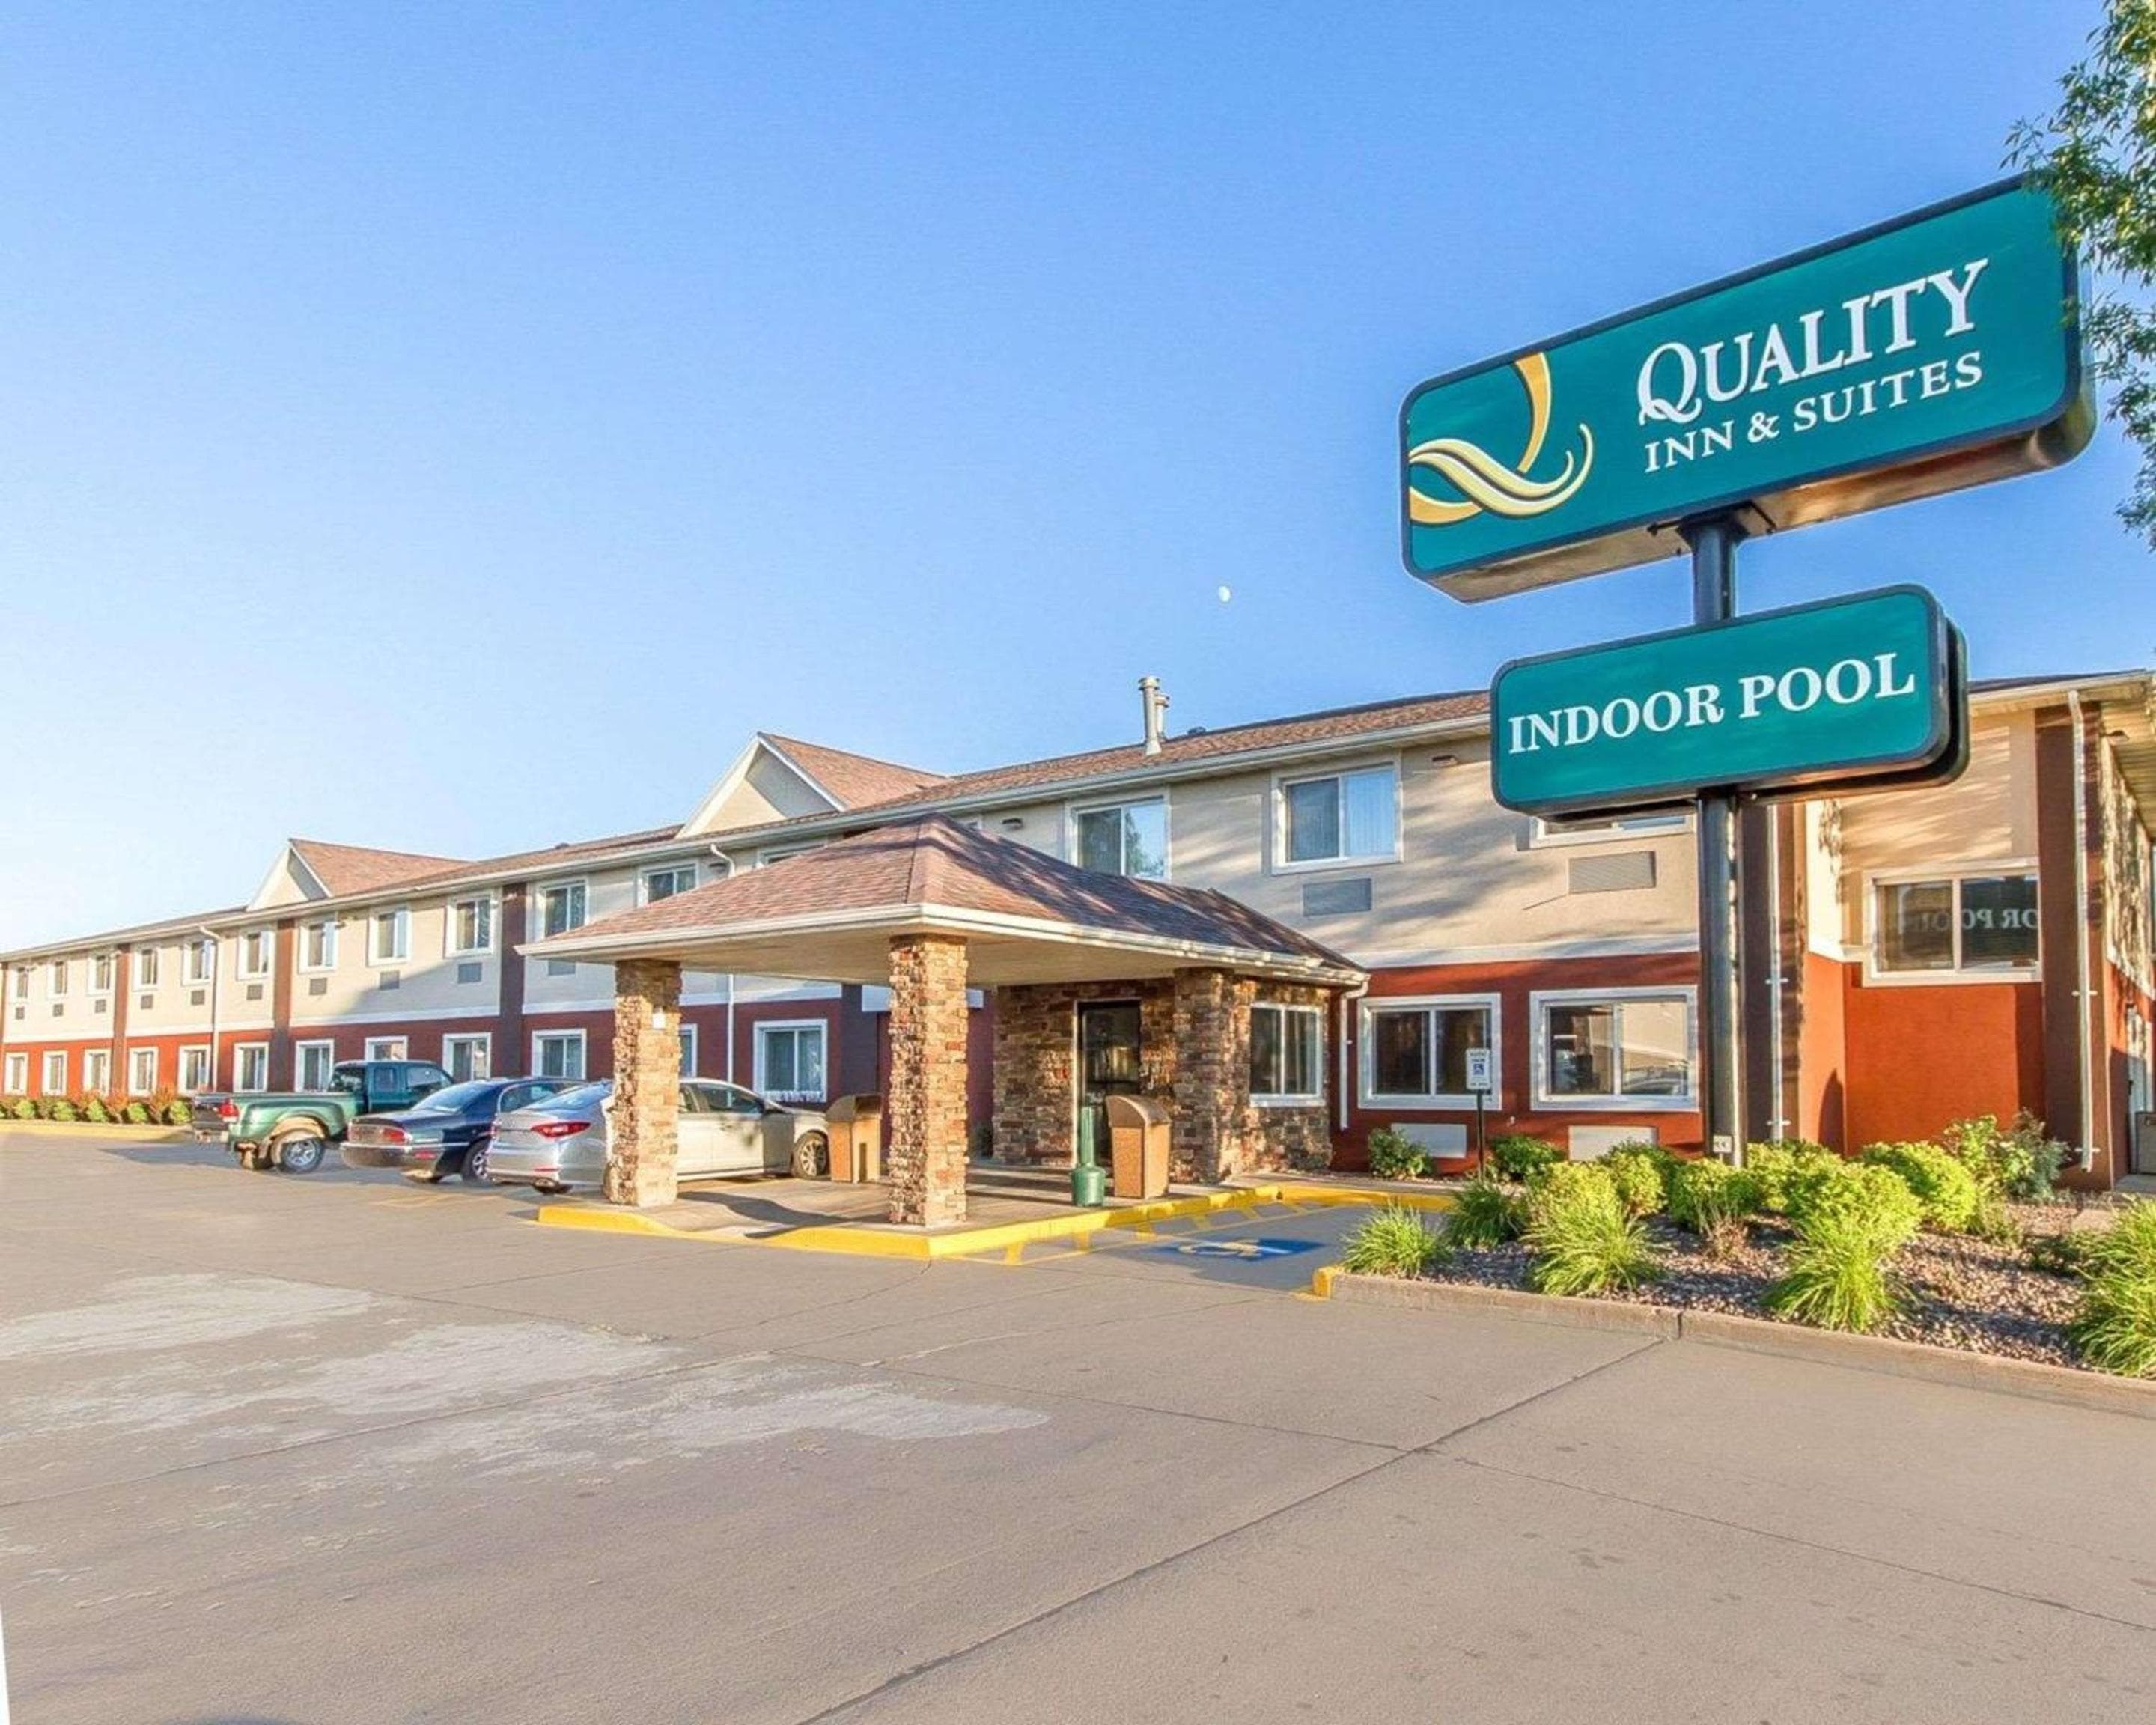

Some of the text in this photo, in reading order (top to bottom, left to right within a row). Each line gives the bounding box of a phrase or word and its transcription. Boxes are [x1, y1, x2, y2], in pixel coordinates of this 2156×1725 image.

[1636, 258, 1988, 426] QUALITY
[1644, 350, 1984, 473] INN & SUITES
[1508, 652, 1916, 754] INDOOR POOL
